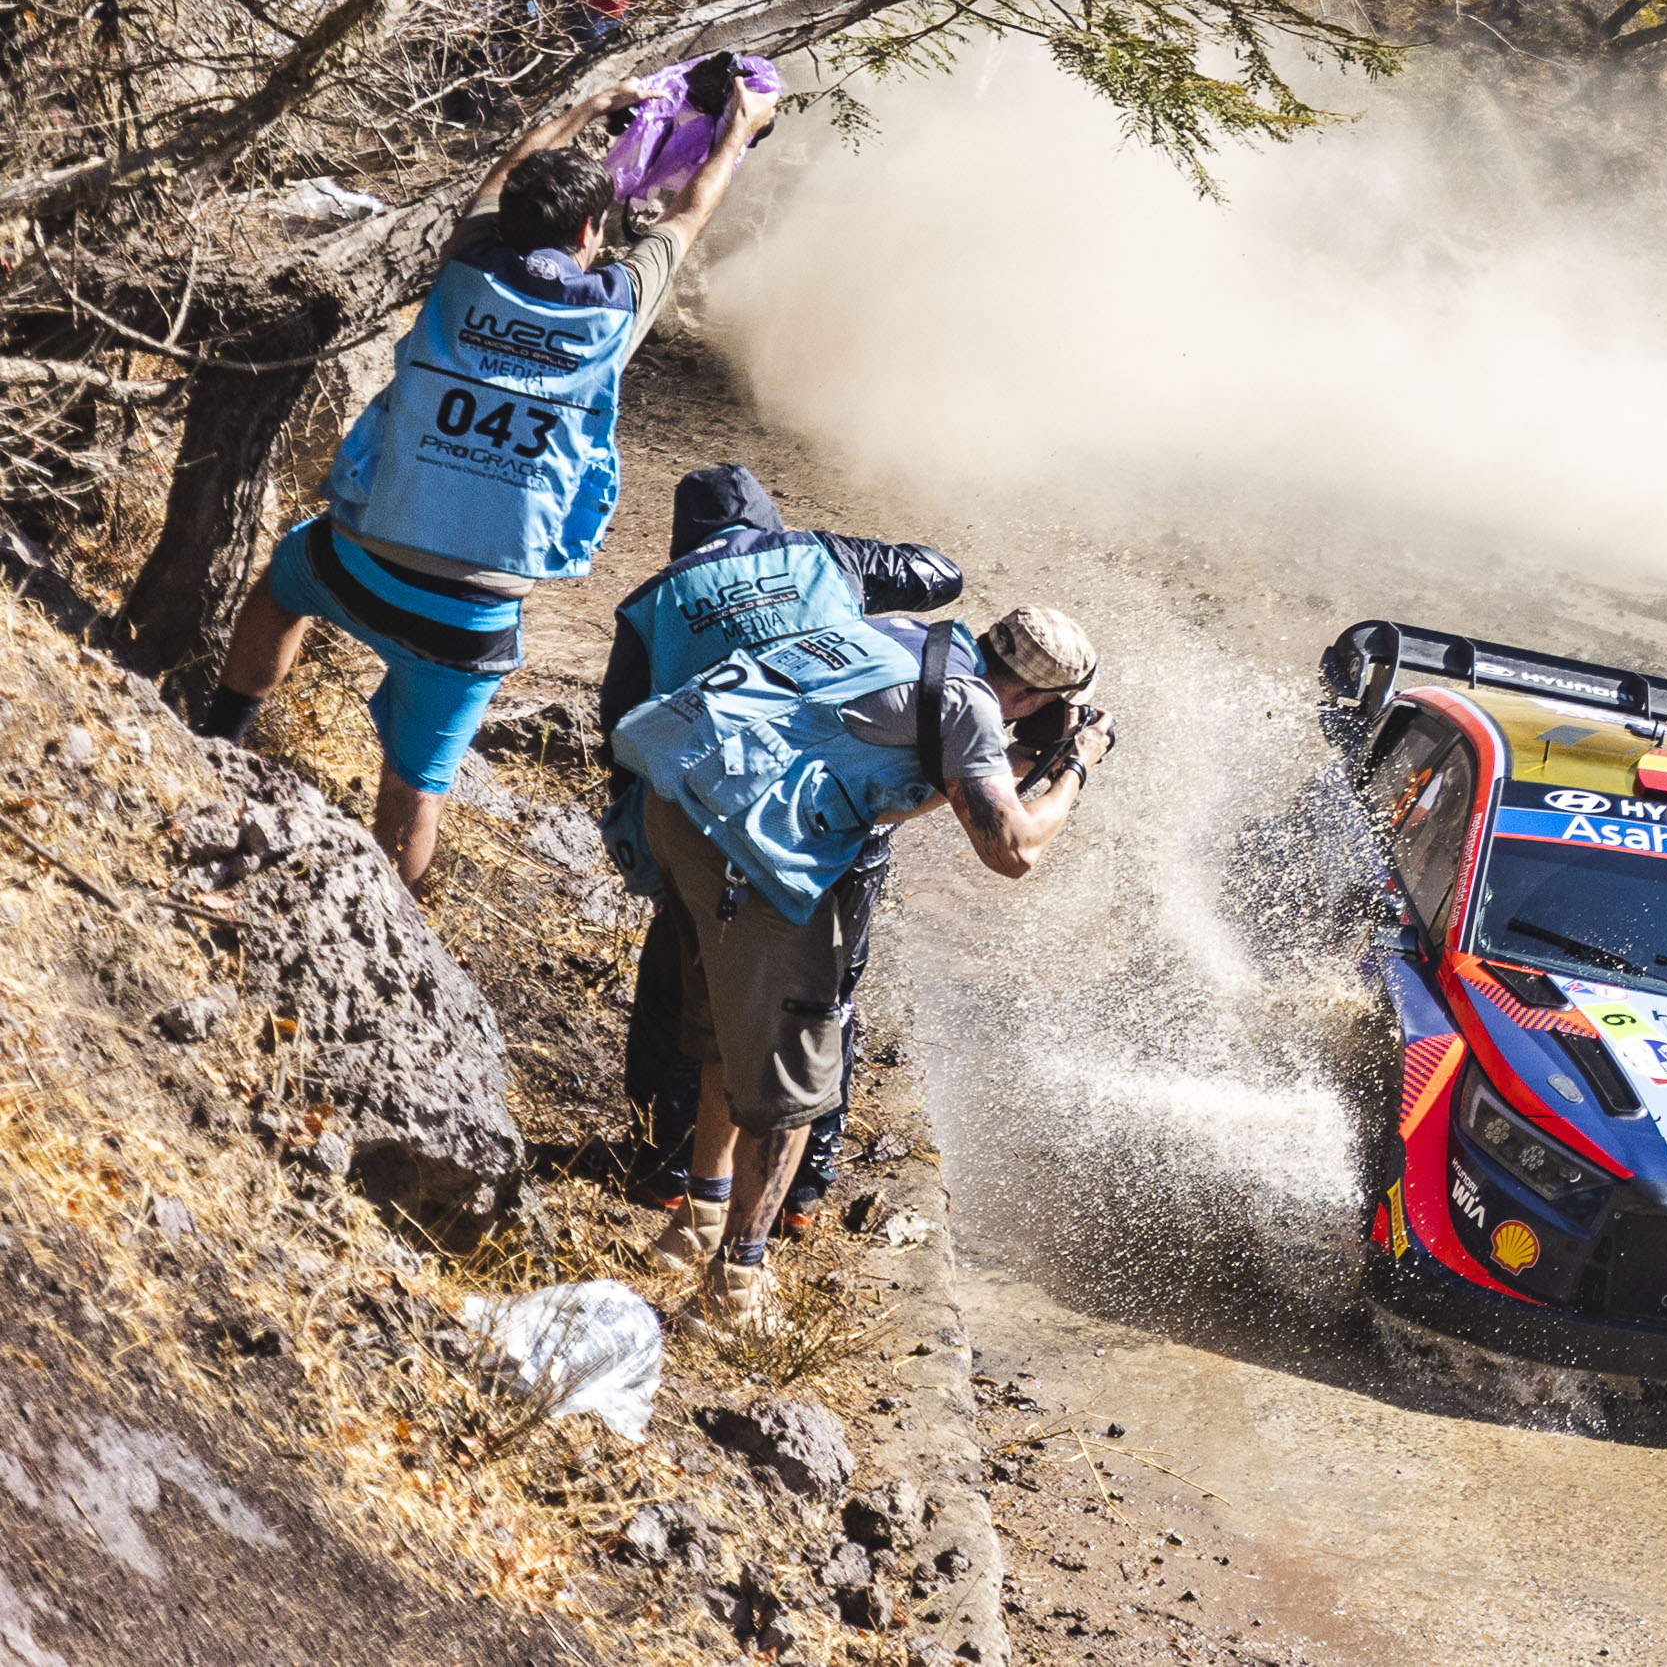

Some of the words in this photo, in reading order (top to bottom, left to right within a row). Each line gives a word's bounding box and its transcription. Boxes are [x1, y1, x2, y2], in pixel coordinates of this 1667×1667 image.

[463, 305, 585, 359] WRC
[479, 355, 543, 387] MEDIA
[436, 388, 560, 459] 043
[680, 572, 798, 621] WRC
[722, 611, 786, 643] MEDIA
[1450, 812, 1482, 929] motorsport.hyundai.com
[1601, 1014, 1637, 1026] 6
[1452, 1157, 1479, 1194] HYUNDAI
